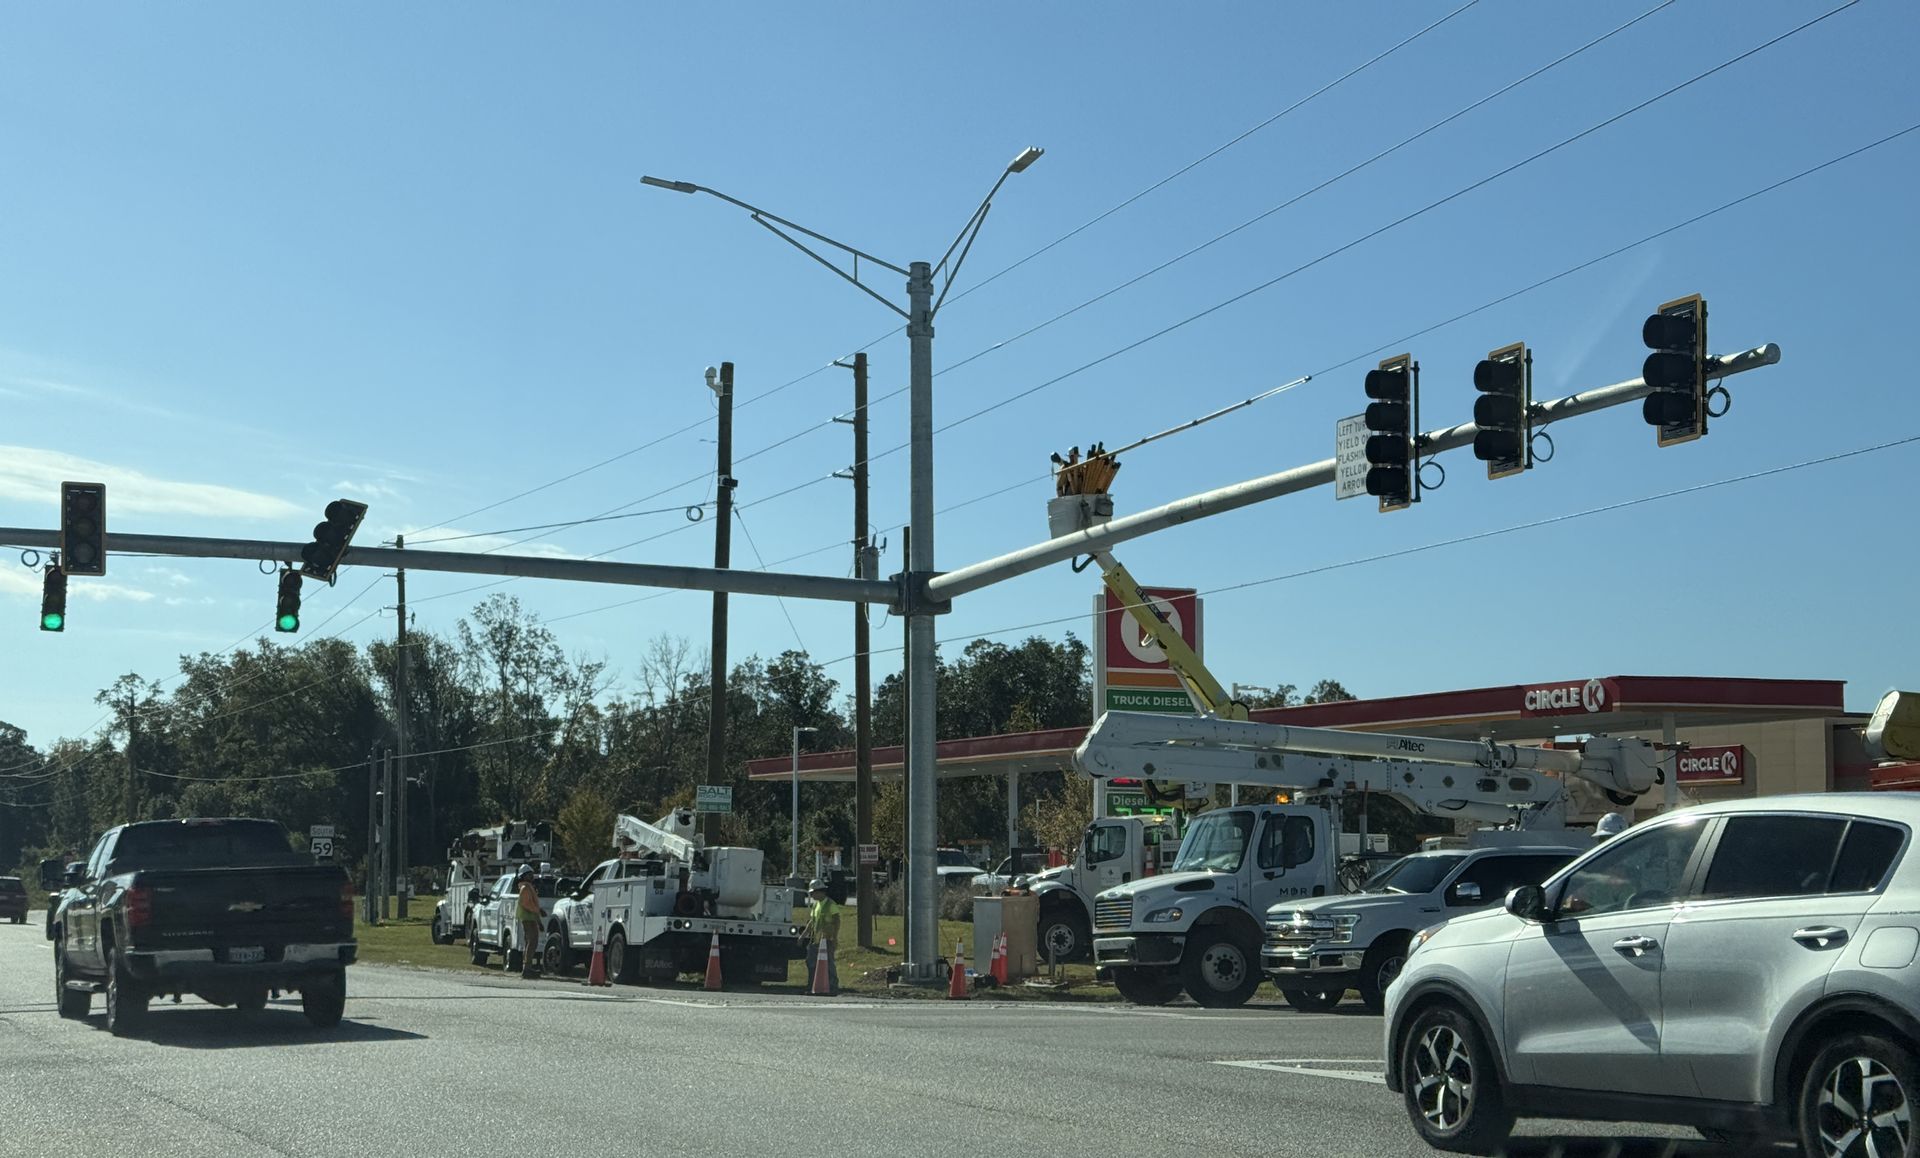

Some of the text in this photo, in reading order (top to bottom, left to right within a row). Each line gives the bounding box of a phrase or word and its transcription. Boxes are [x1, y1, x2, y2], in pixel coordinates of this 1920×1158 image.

[1339, 420, 1366, 437] LEFT TUR
[1338, 436, 1359, 450] YIELD
[1338, 449, 1366, 464] FLASHIN
[1341, 463, 1368, 478] YELLOW
[1342, 478, 1366, 492] ARROW
[1113, 695, 1192, 707] TRUCK DIESEL
[1525, 682, 1603, 711] CIRCLE K
[1398, 739, 1425, 752] Altec
[1680, 753, 1736, 774] CIRCLE K
[698, 786, 731, 795] SALT
[1112, 795, 1147, 806] Diesel
[313, 842, 332, 855] 59
